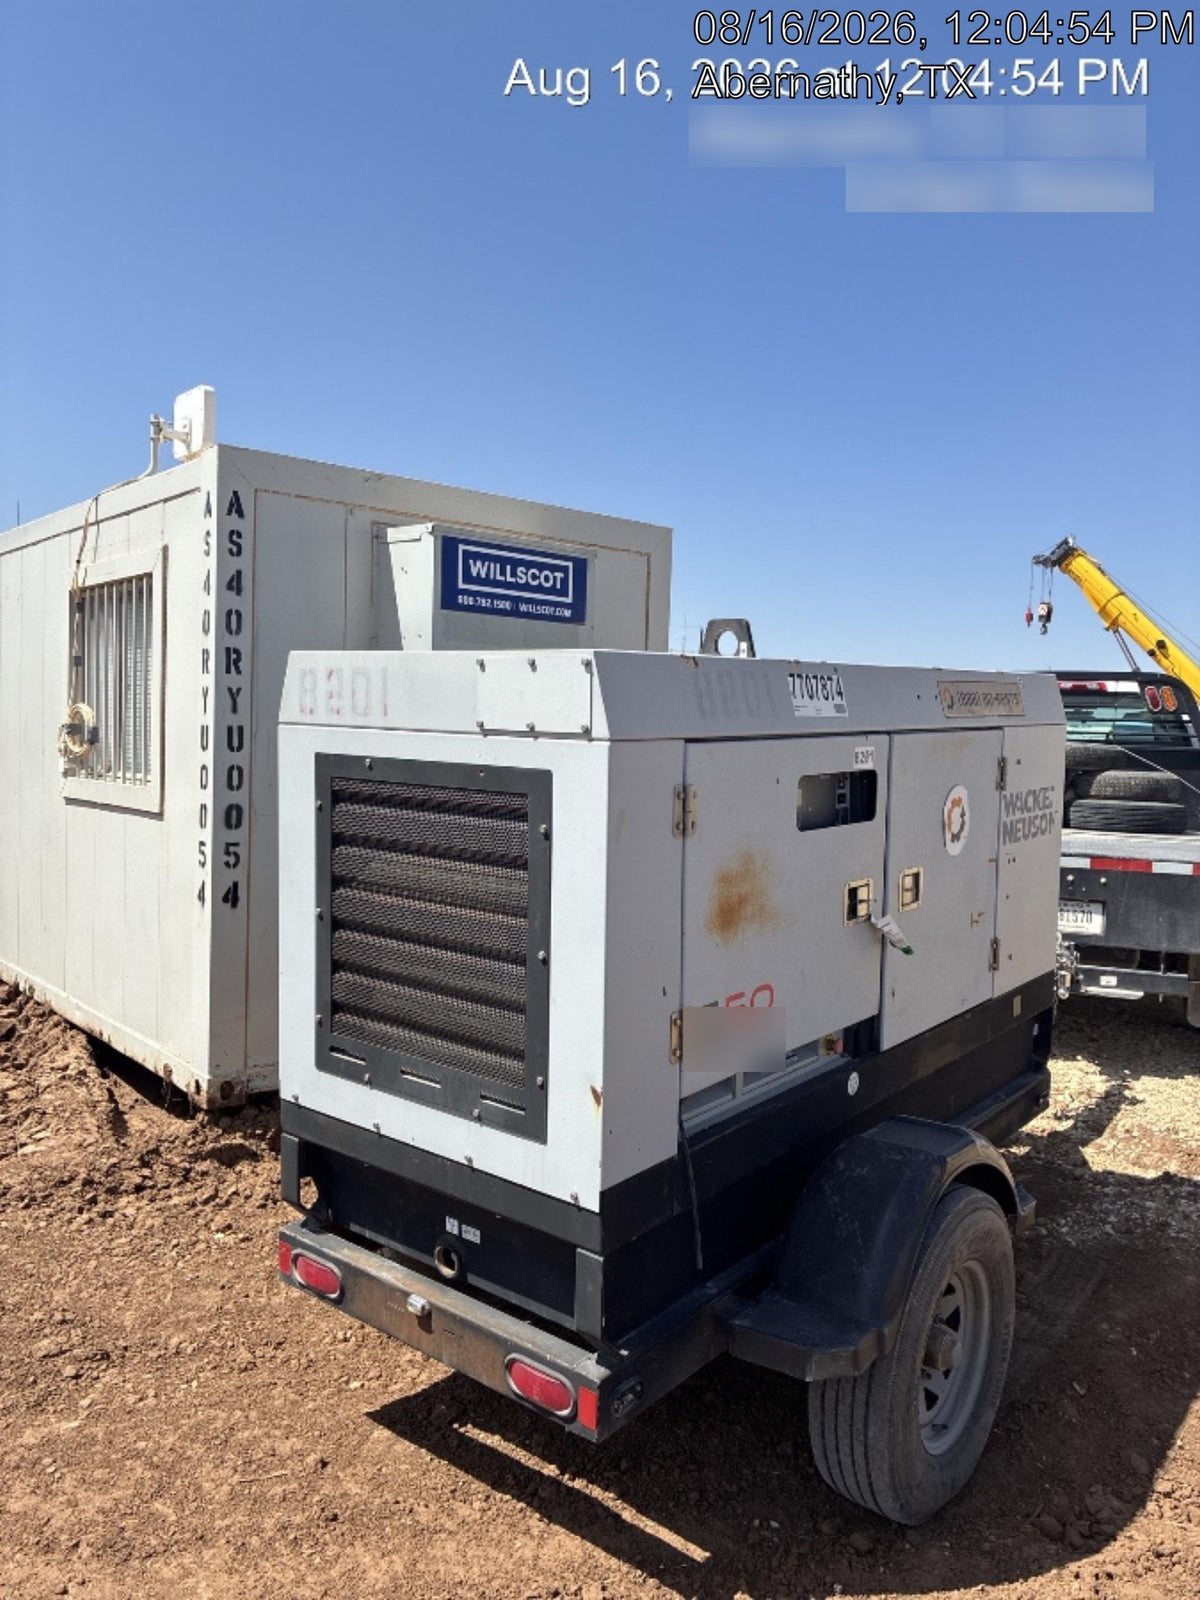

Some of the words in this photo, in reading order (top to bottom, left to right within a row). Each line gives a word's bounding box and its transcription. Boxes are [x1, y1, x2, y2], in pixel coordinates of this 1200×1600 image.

[469, 559, 564, 590] WILLSCOT
[788, 672, 844, 702] 7707874
[1003, 785, 1056, 818] WACKE
